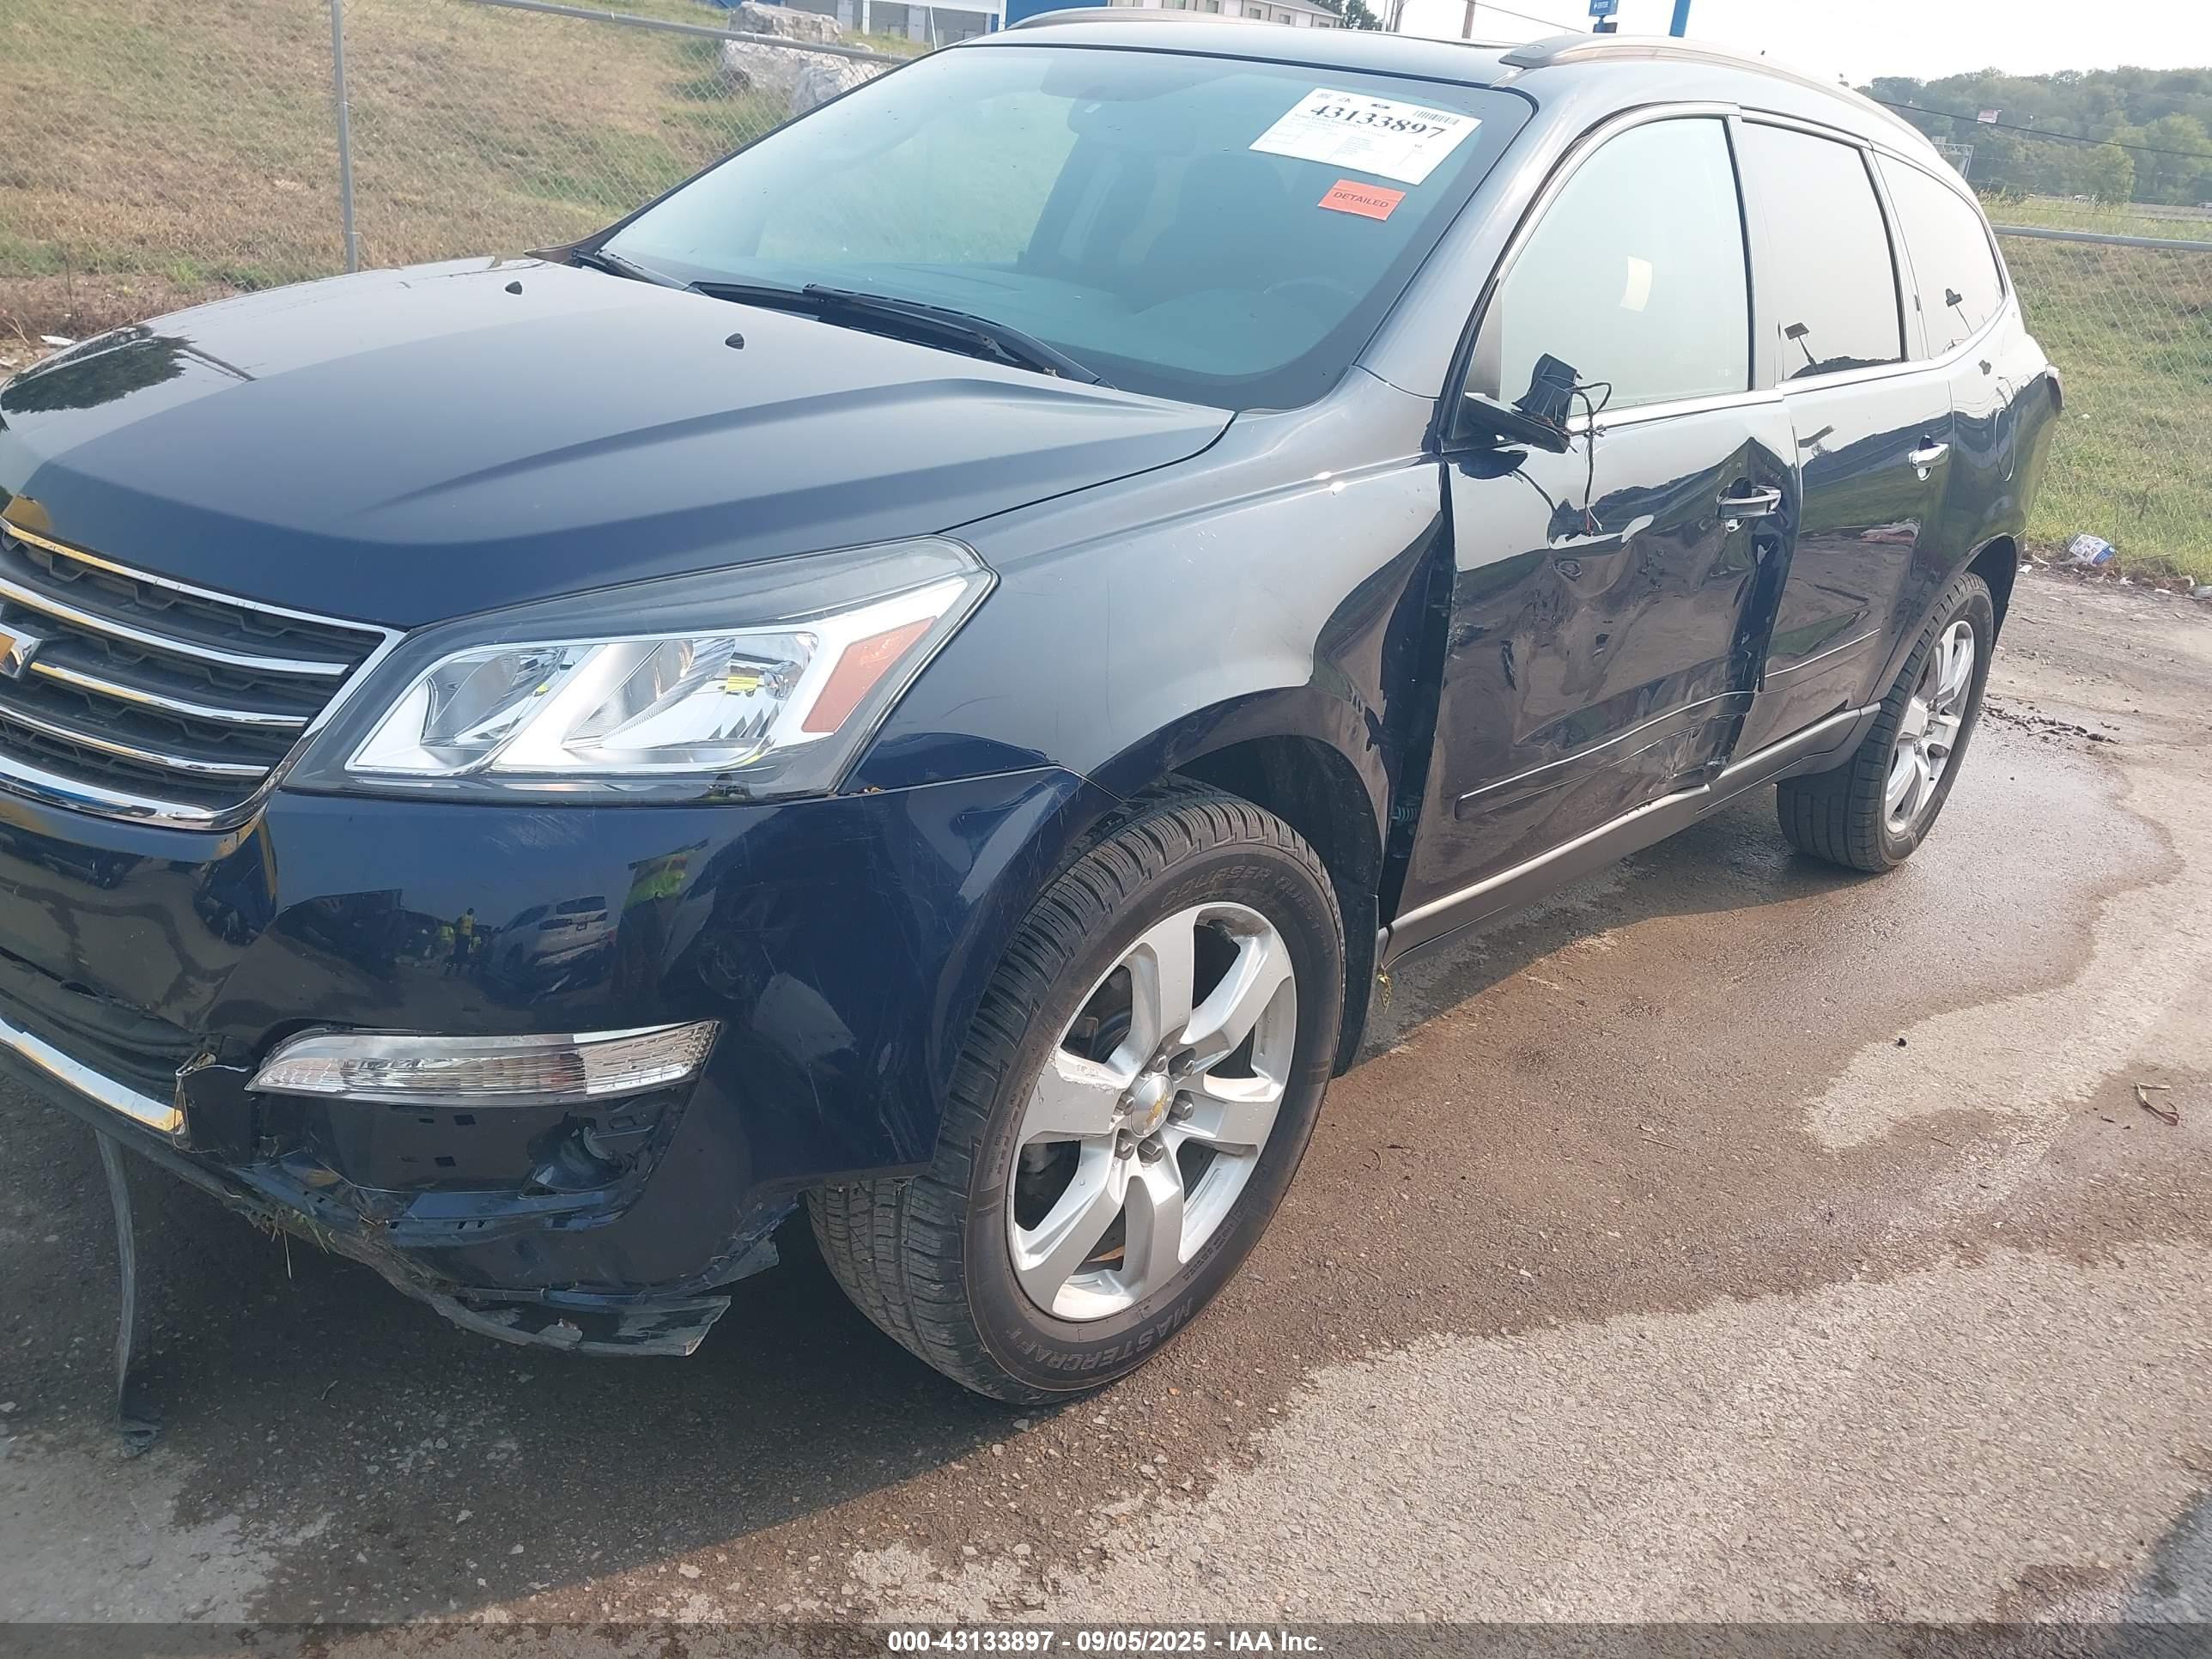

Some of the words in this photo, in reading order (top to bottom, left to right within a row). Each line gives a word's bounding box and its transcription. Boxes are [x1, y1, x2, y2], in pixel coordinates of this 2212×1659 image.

[1310, 105, 1447, 138] 43133897
[1333, 191, 1389, 208] DETAILED
[1006, 1297, 1194, 1371] MASTERCRAFT
